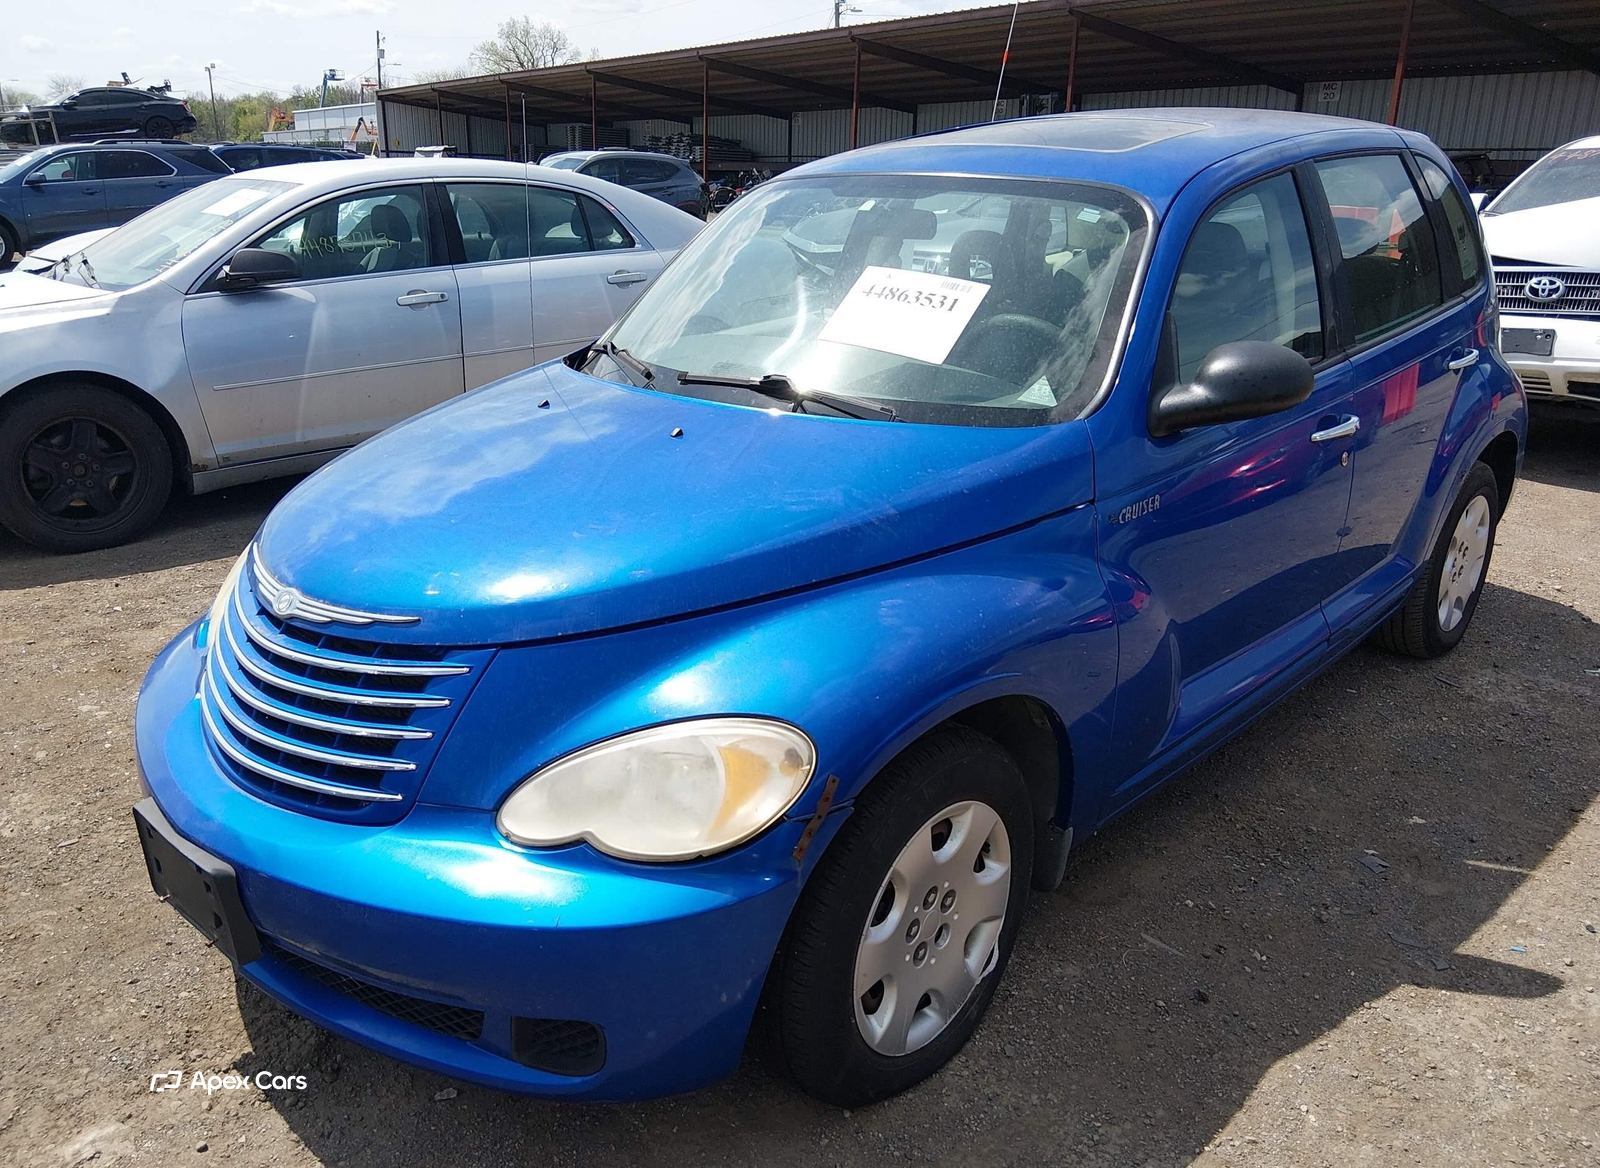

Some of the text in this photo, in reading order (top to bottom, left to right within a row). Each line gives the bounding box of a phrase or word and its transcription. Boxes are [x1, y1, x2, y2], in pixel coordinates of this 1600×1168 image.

[1322, 83, 1338, 91] MC
[1323, 92, 1335, 100] 20
[862, 284, 960, 312] 44863531
[1119, 494, 1161, 524] CRUISER
